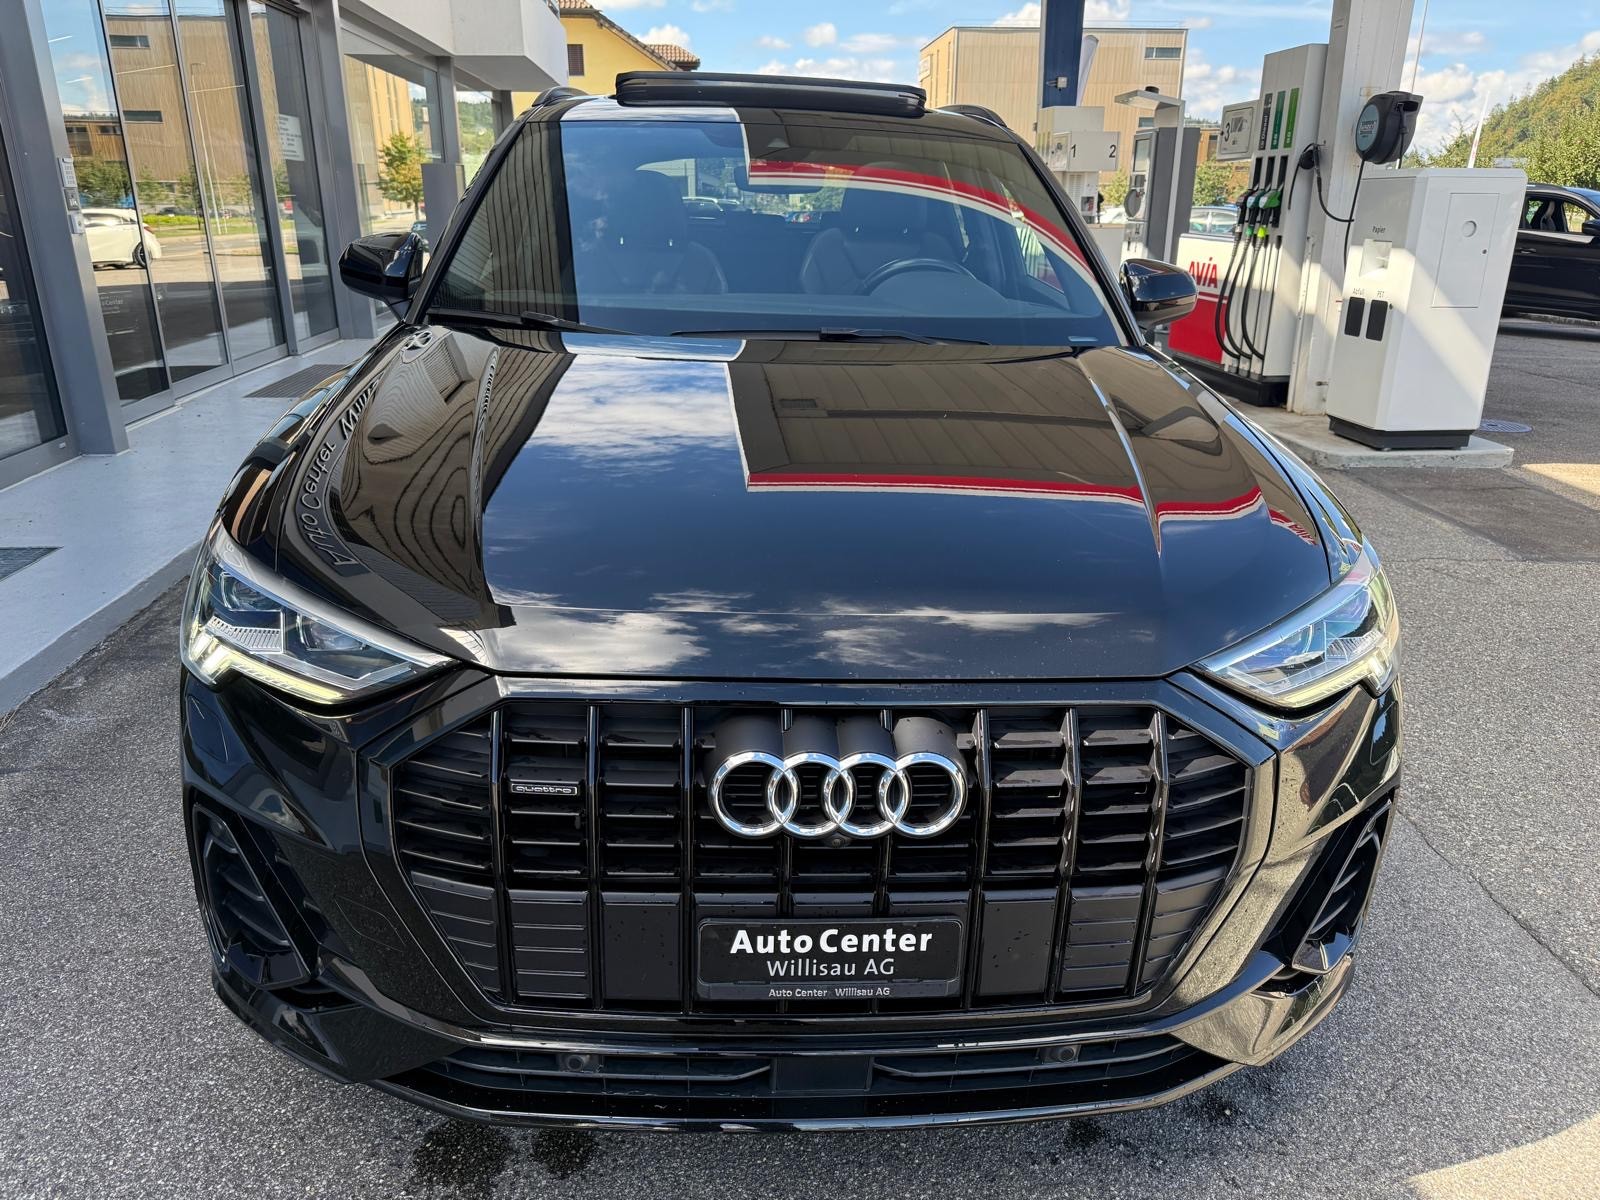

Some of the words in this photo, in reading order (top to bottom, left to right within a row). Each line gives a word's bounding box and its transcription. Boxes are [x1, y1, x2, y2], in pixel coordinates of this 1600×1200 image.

[1224, 122, 1231, 142] 3
[1071, 144, 1077, 158] 1
[1109, 144, 1117, 158] 2
[515, 785, 572, 794] quattro
[730, 929, 813, 954] Auto
[819, 928, 933, 953] Center
[766, 958, 856, 977] Willisau
[864, 958, 895, 976] AG
[768, 988, 793, 997] Auto
[795, 987, 828, 997] Center
[835, 987, 874, 997] Willisau
[875, 987, 891, 996] AG
